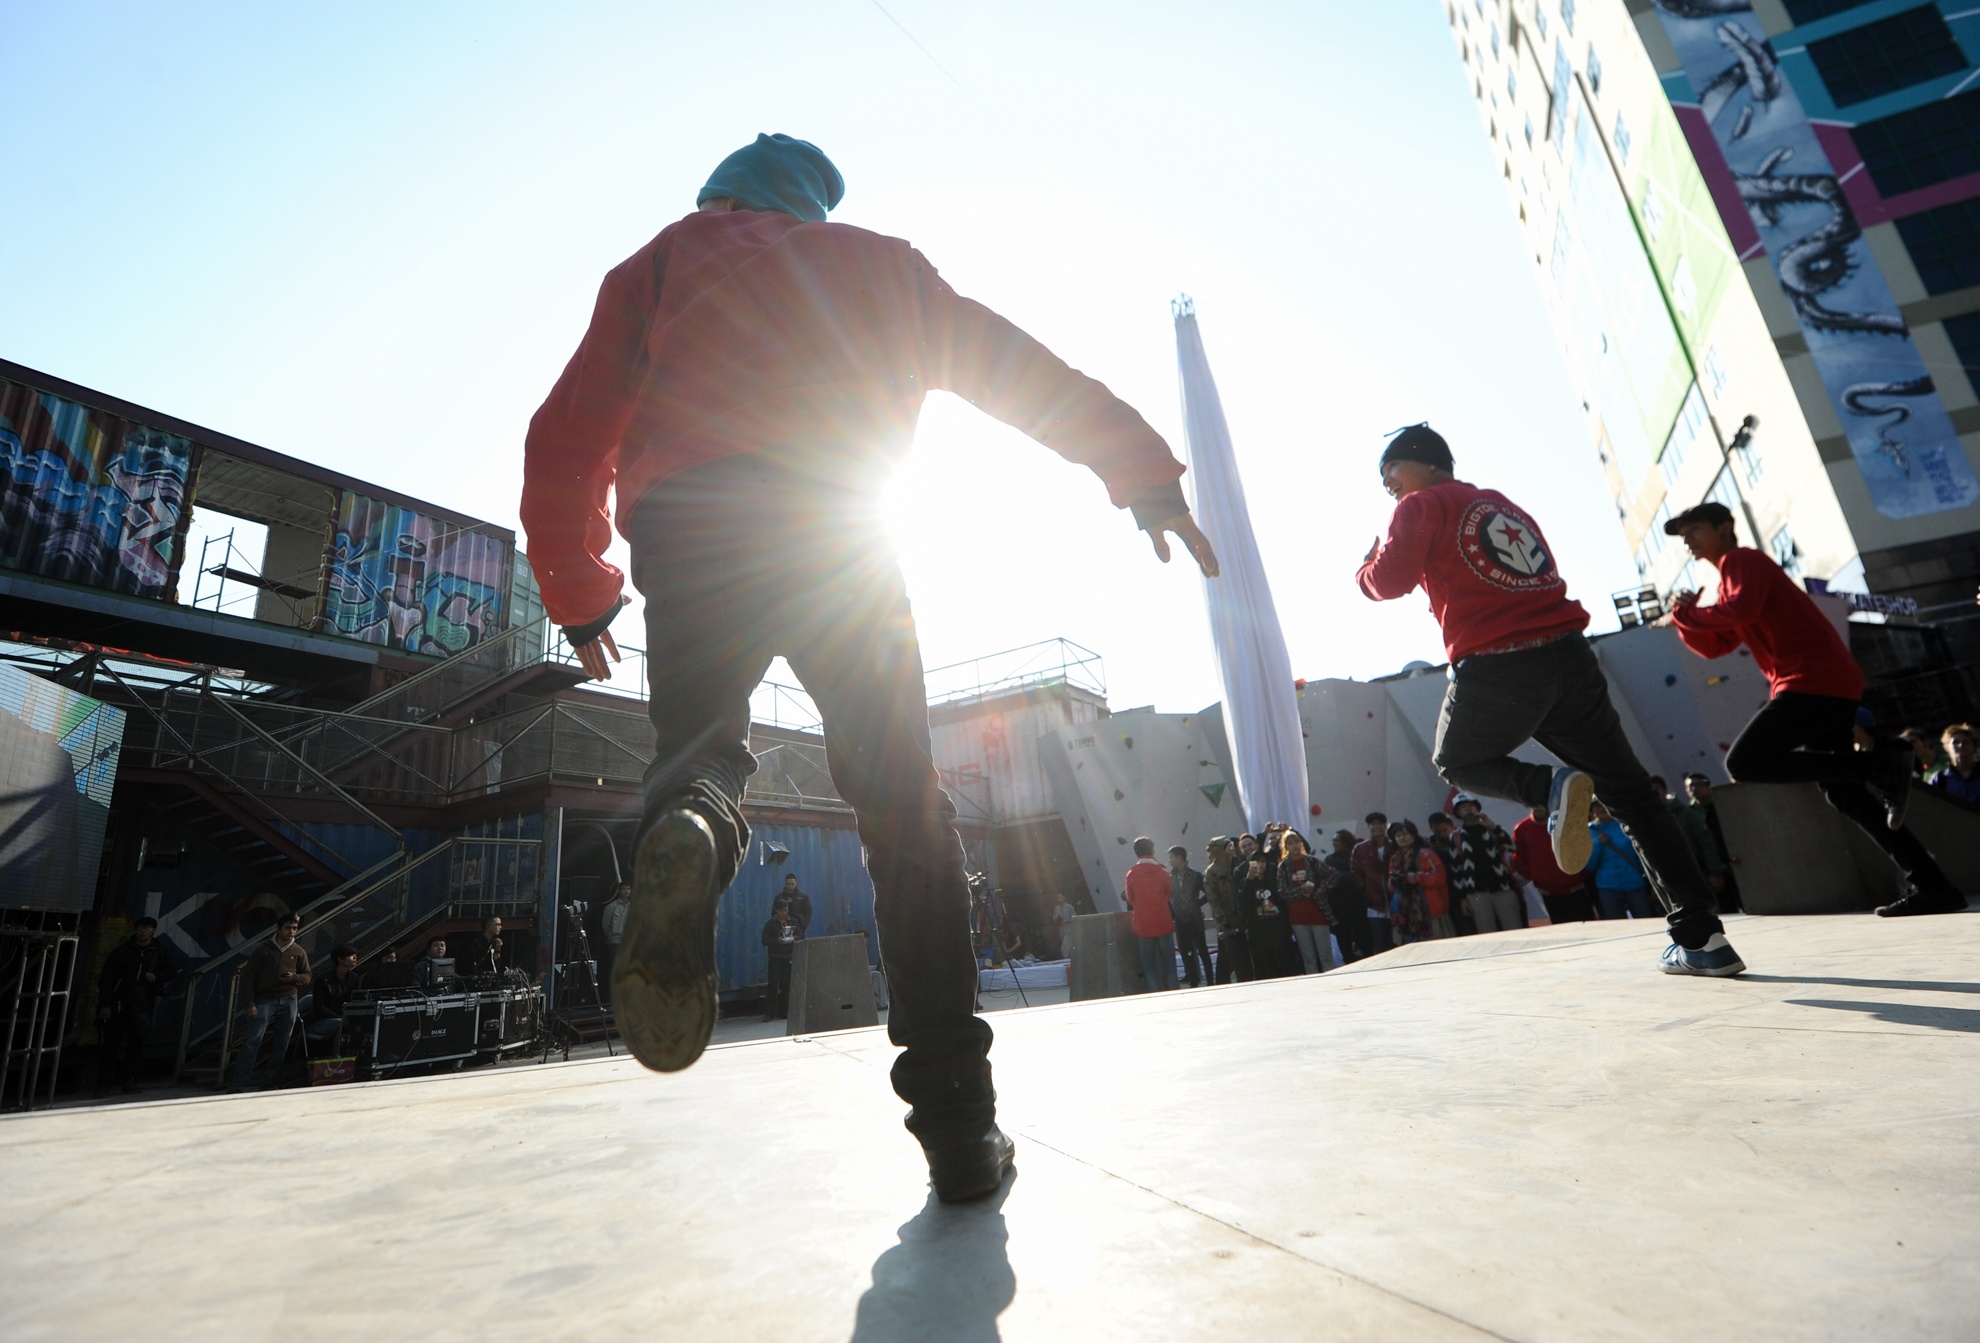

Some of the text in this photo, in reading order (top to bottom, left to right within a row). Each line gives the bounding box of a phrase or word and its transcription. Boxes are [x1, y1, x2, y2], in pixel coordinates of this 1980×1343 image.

[1465, 504, 1498, 536] BIGTOE
[1490, 568, 1541, 586] SINCE
[1836, 592, 1918, 615] KATESHOP
